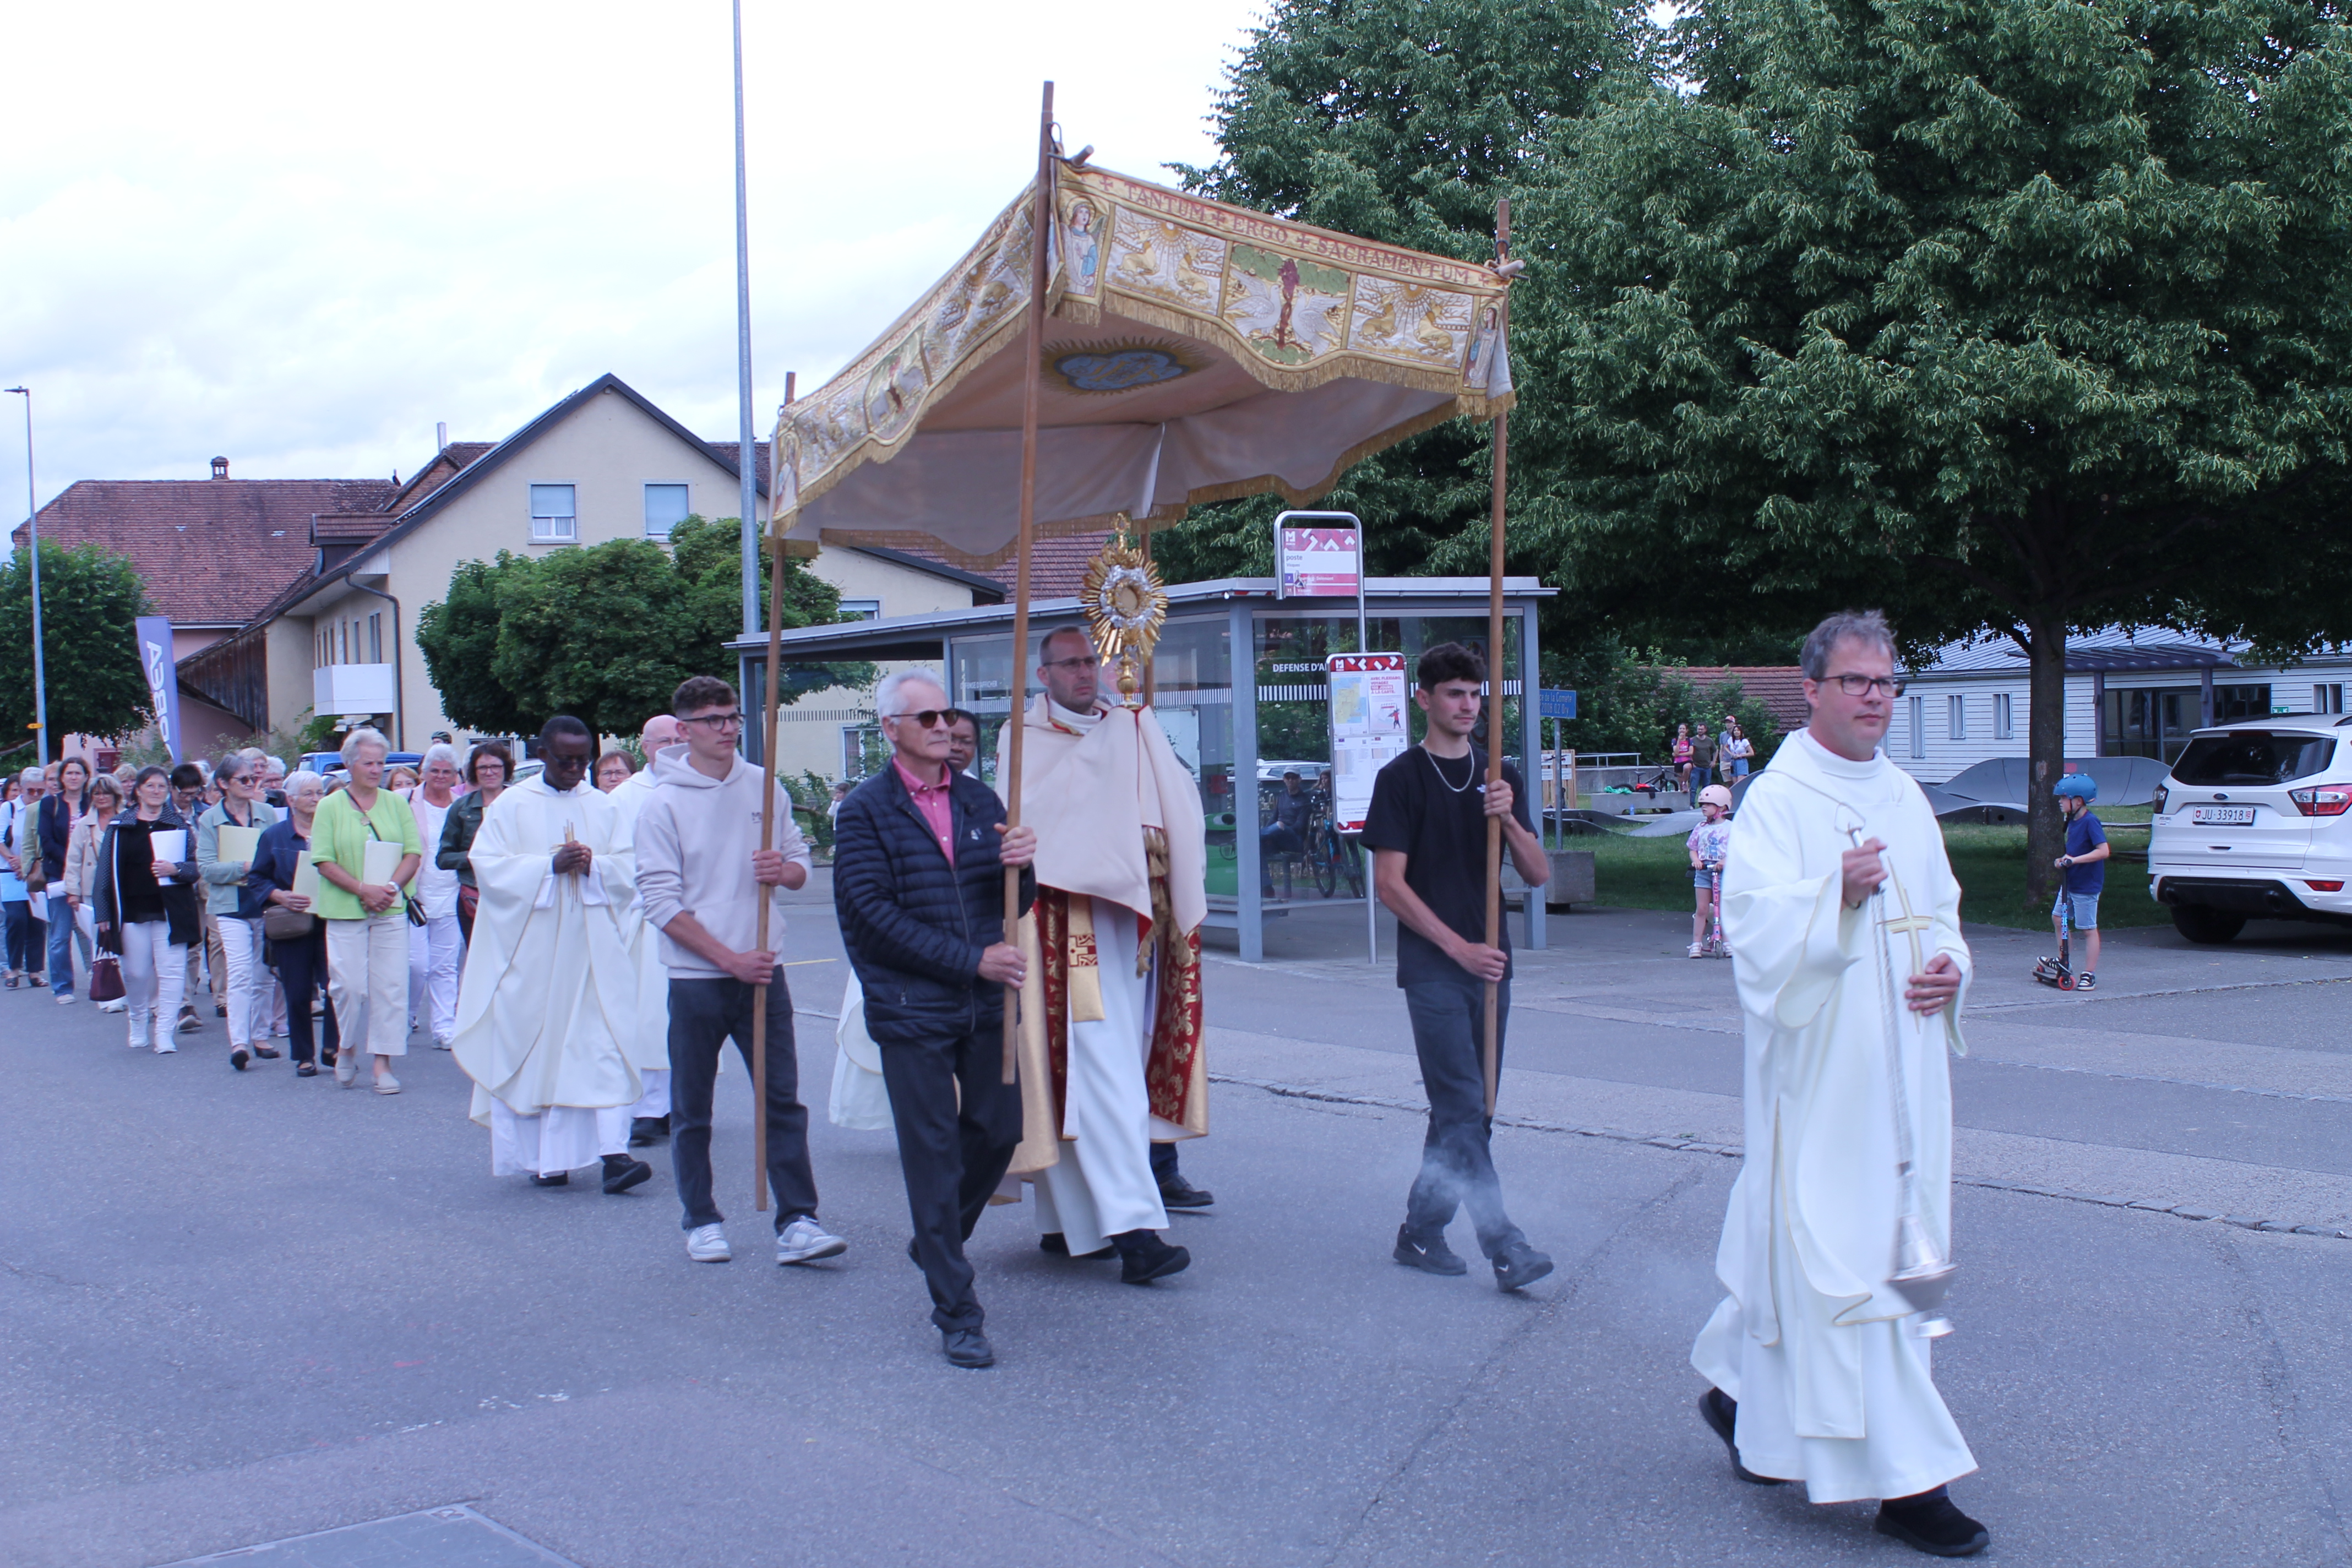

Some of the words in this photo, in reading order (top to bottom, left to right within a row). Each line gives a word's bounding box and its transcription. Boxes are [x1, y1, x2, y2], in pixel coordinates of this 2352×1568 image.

[1124, 181, 1205, 221] TANTUM
[1233, 214, 1288, 243] ERGO
[1317, 236, 1469, 284] SACRAMENTUM
[1272, 663, 1309, 672] DEFENSE
[1544, 692, 1550, 701] de
[1550, 692, 1555, 702] la
[1542, 703, 1553, 713] 2008
